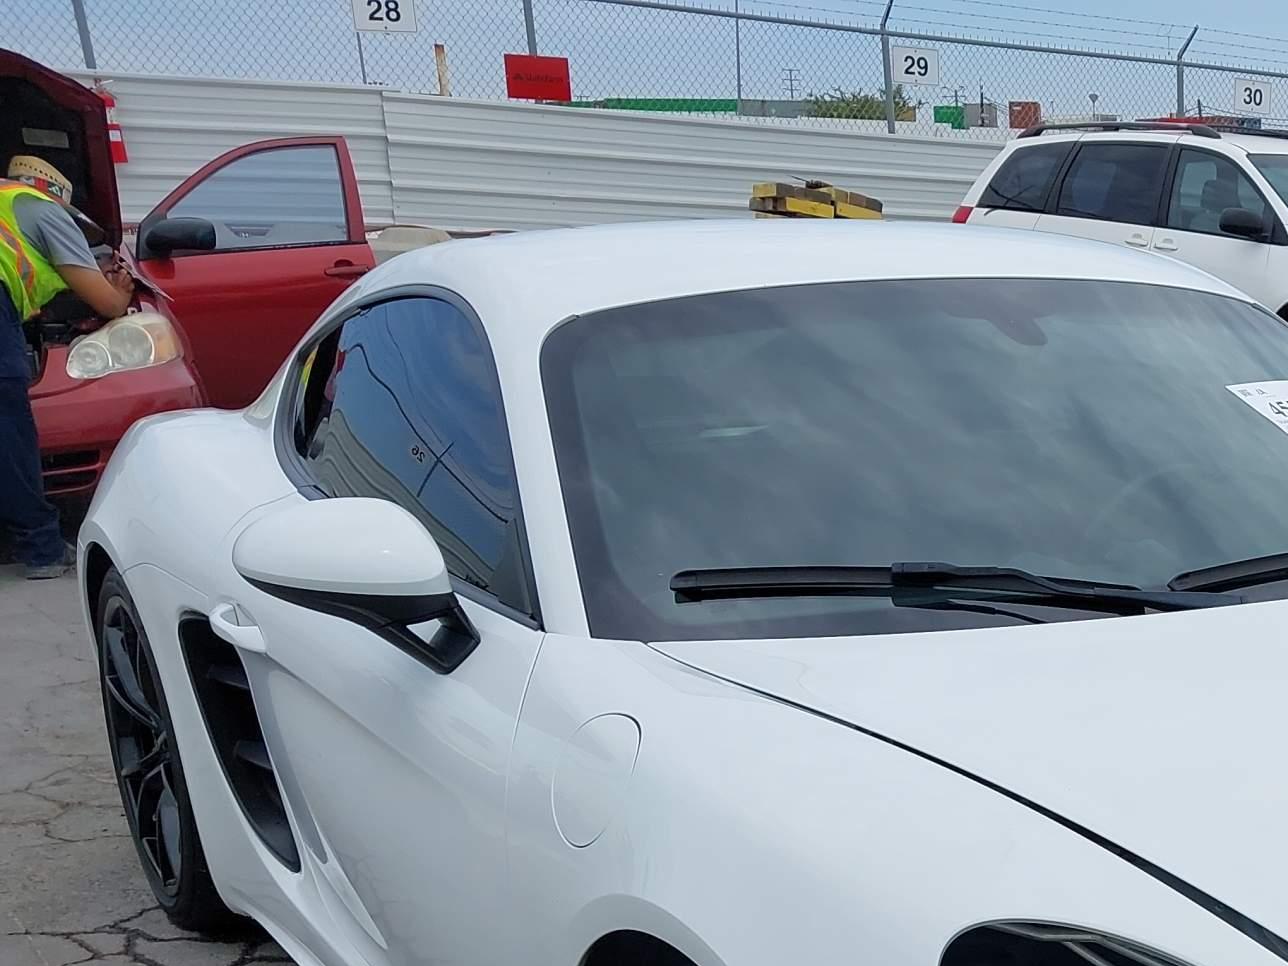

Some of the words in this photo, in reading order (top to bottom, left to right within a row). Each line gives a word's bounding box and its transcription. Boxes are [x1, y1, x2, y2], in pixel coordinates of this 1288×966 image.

[367, 0, 401, 22] 28
[904, 55, 928, 76] 29
[1243, 87, 1263, 106] 30
